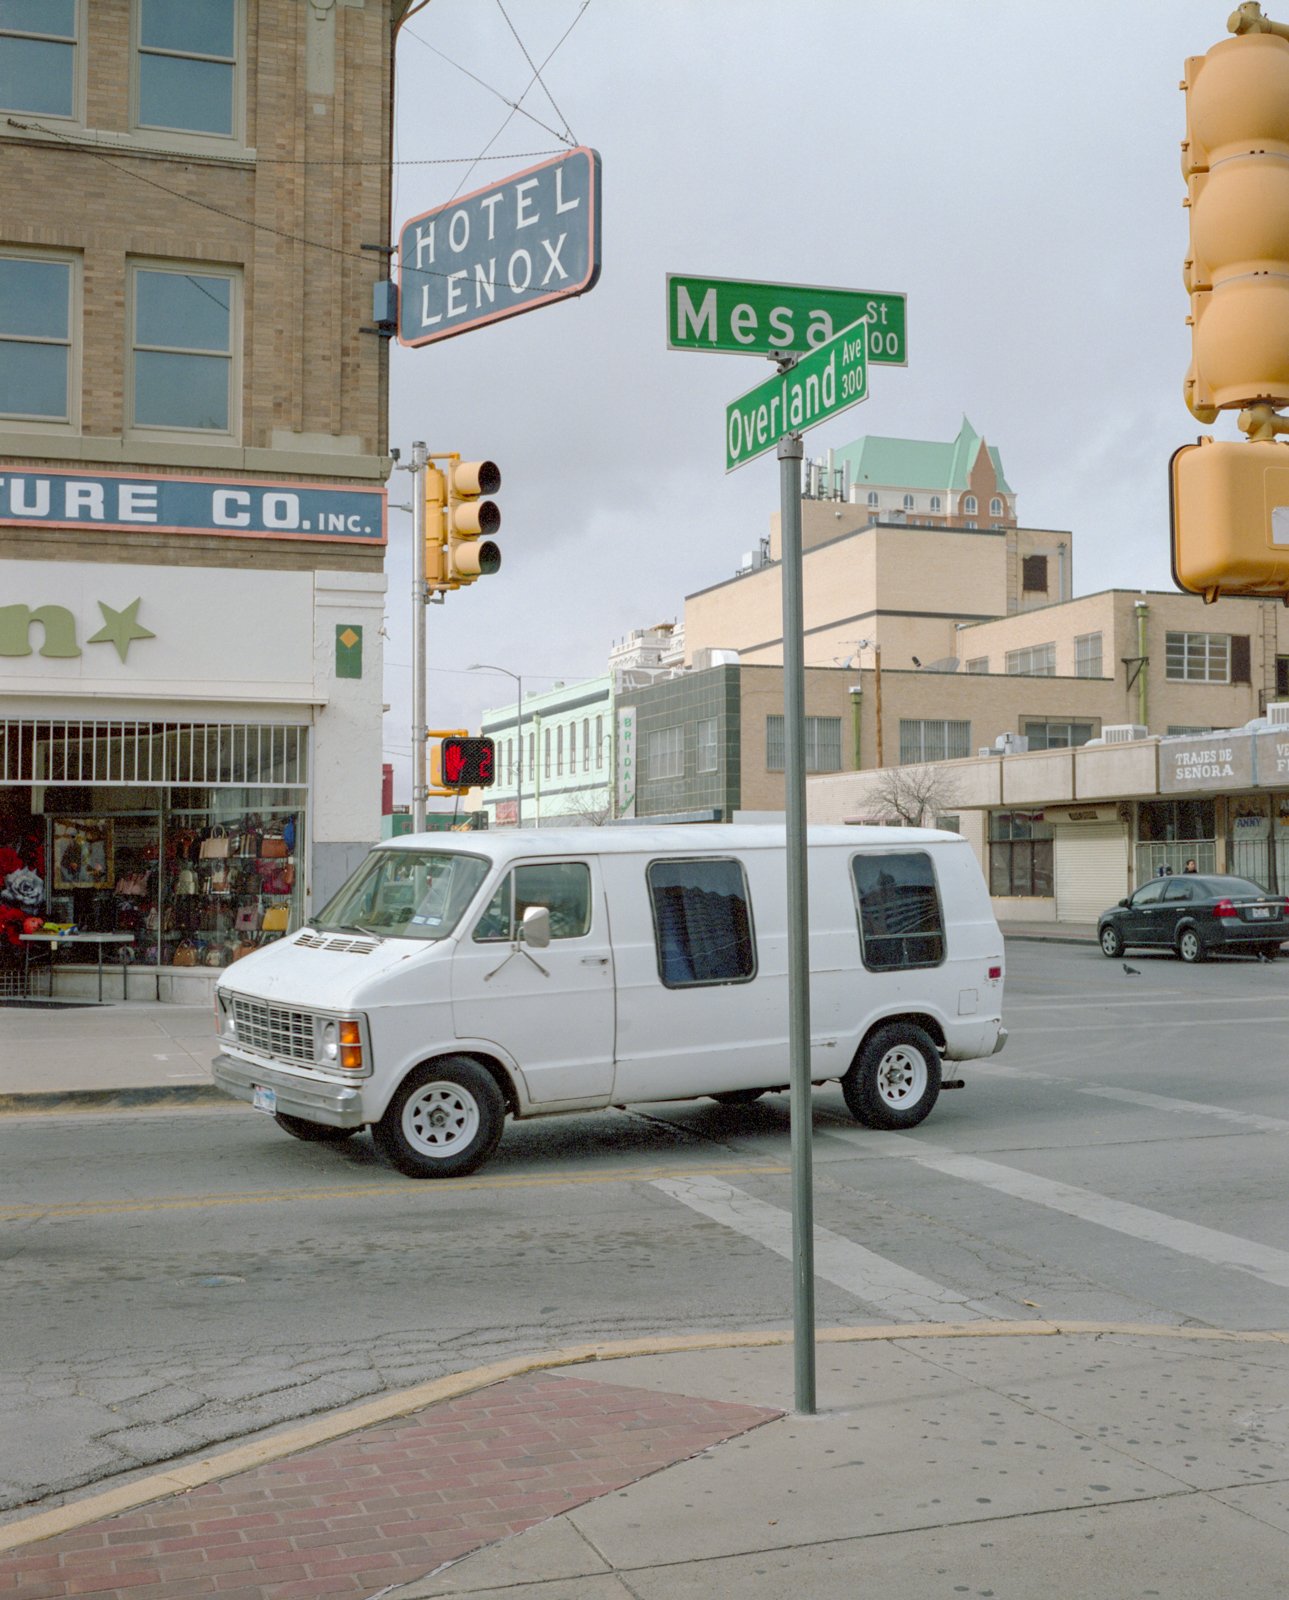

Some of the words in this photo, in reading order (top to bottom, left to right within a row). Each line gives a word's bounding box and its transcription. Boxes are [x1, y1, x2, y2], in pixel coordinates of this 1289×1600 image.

[416, 167, 580, 269] HOTEL
[421, 233, 568, 327] LENOX
[677, 285, 833, 349] Mesa
[866, 301, 888, 325] St
[870, 331, 898, 355] 00
[729, 349, 836, 459] Overland
[842, 338, 862, 366] Ave
[841, 366, 863, 399] 300
[0, 478, 158, 522] URE
[212, 489, 311, 530] CO.
[318, 512, 371, 533] INC.
[624, 717, 632, 793] BRIDAL
[1175, 750, 1216, 765] TRAJES
[1218, 748, 1233, 762] DE
